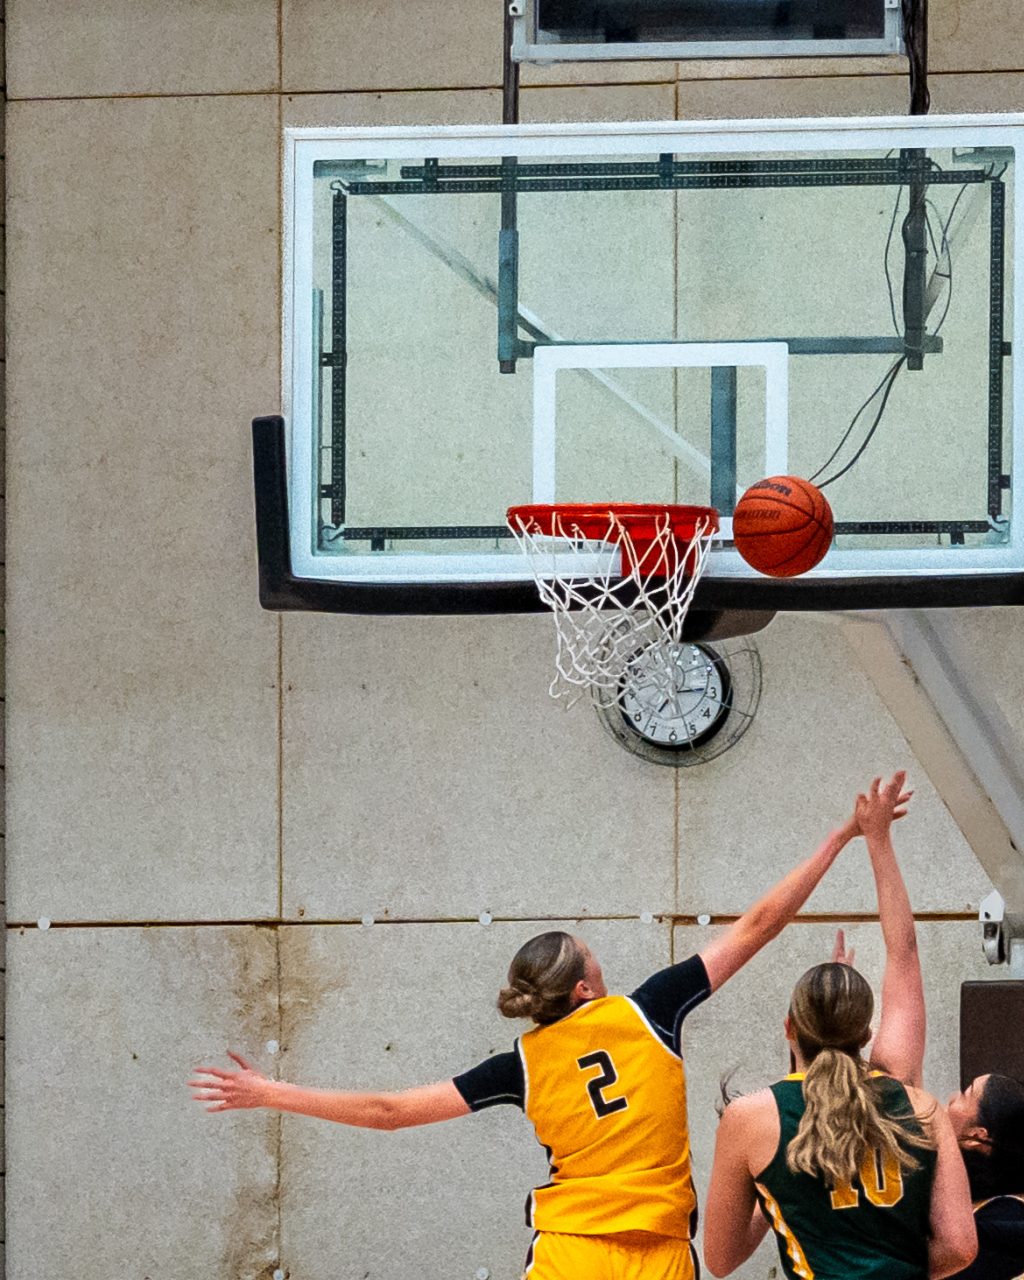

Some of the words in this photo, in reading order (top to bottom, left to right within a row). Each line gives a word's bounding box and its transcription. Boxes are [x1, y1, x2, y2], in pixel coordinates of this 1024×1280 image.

[710, 687, 717, 699] 3
[702, 707, 711, 718] 4
[576, 1048, 629, 1120] 2
